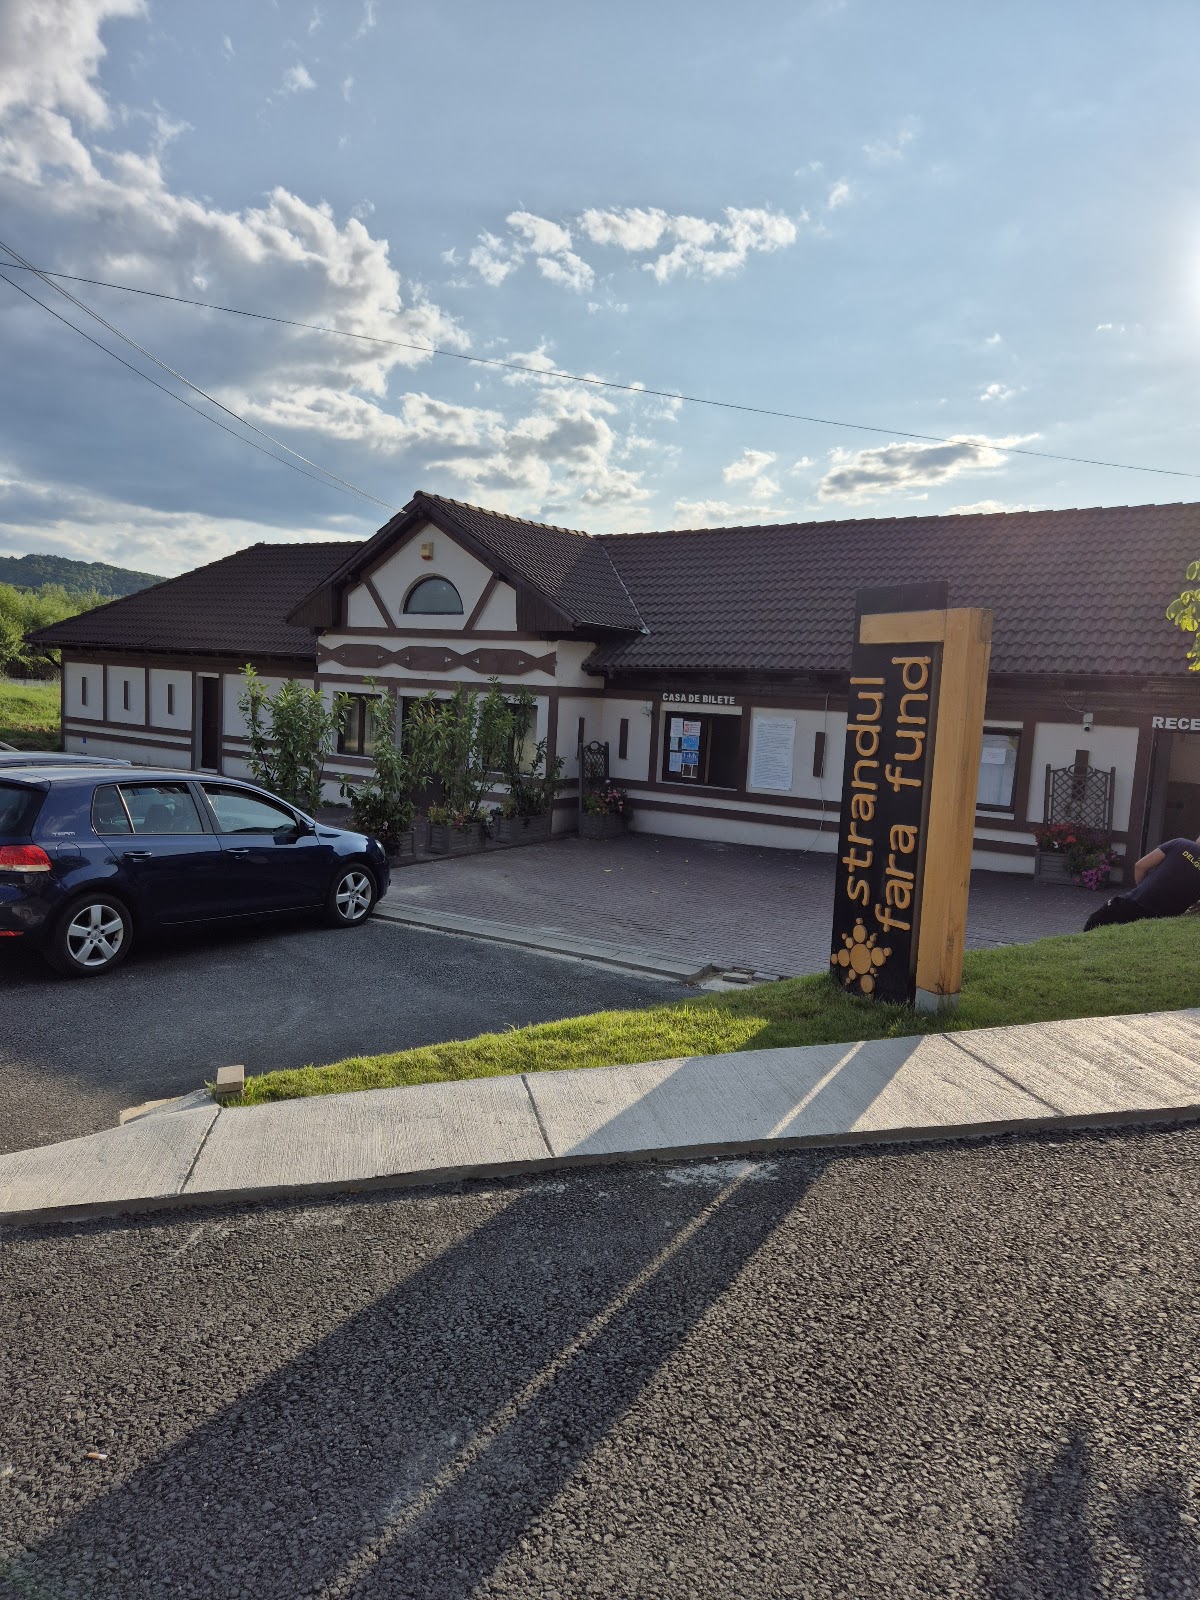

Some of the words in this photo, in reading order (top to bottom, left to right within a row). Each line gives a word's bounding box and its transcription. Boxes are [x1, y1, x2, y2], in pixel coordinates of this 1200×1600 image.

[662, 693, 686, 702] CASA
[688, 694, 700, 703] DE
[702, 695, 735, 705] BILETE
[885, 656, 931, 792] fund
[843, 677, 886, 906] strandul
[875, 824, 918, 932] fara
